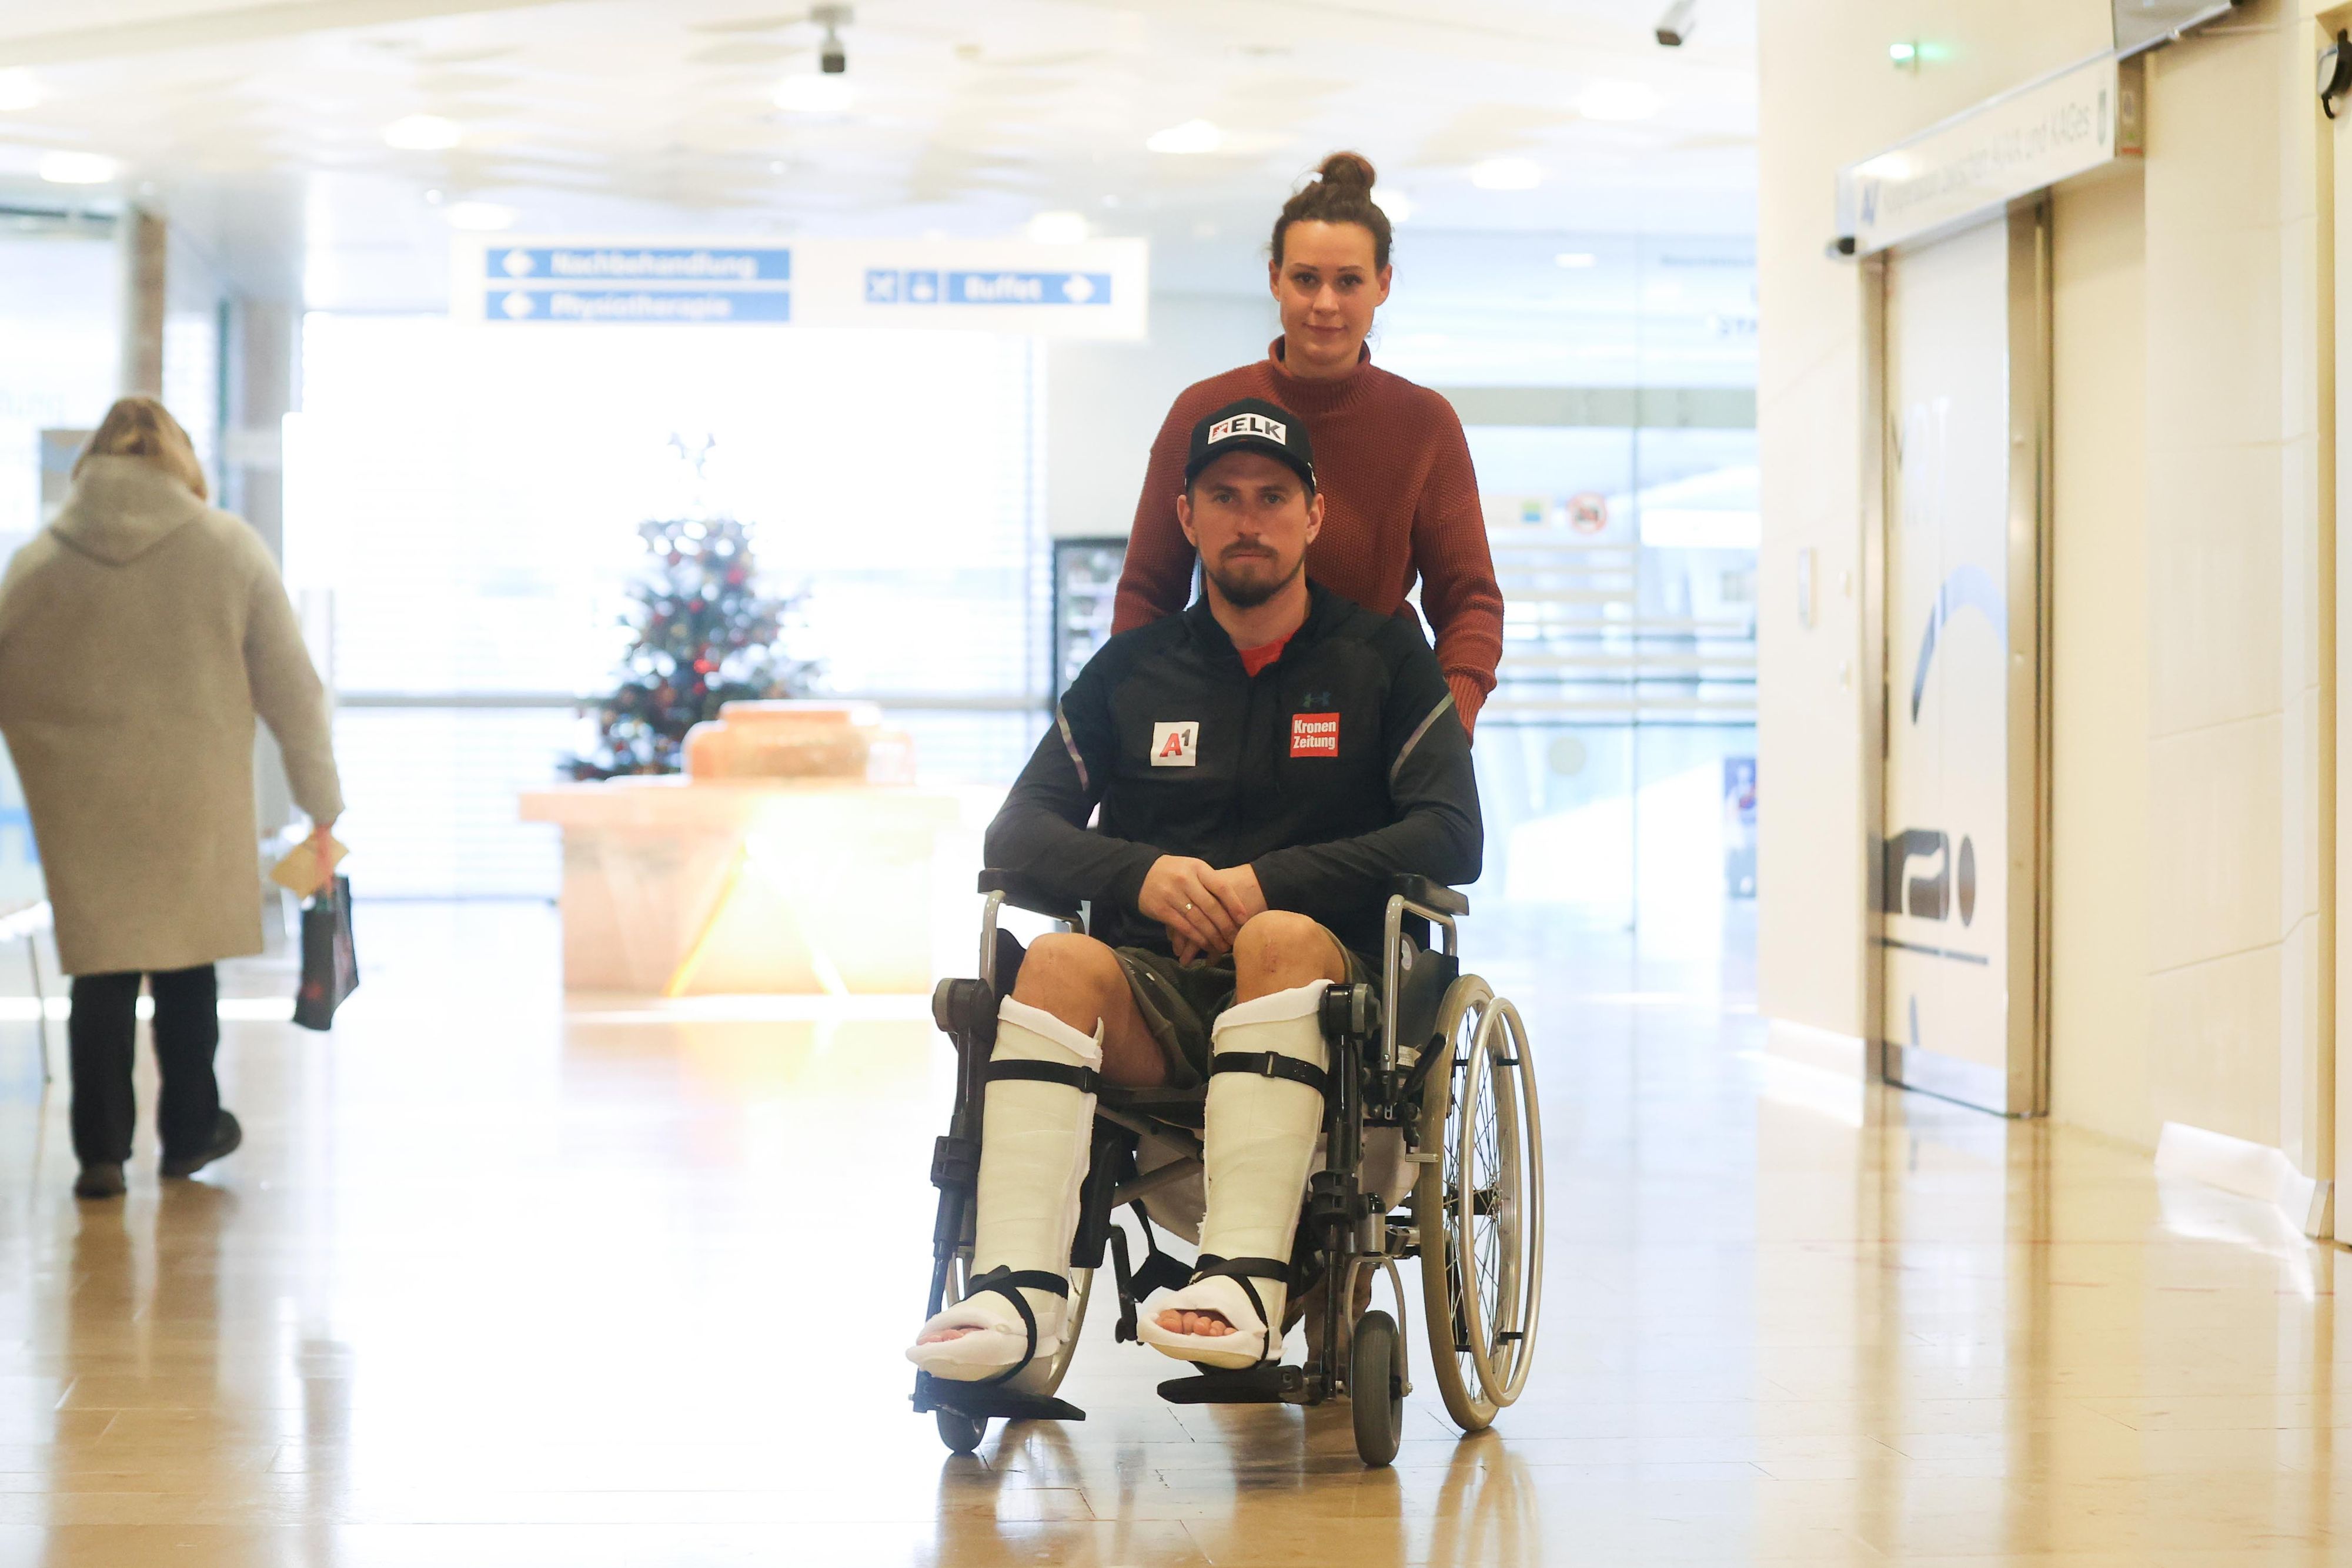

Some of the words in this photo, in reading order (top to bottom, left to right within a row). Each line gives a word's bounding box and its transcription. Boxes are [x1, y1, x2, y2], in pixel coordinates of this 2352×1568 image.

[551, 250, 757, 280] Nachbehandlung
[965, 274, 1043, 301] Buffet
[551, 293, 731, 321] Physiotherapie
[1231, 417, 1282, 440] ELK
[1294, 720, 1337, 734] Kronen
[1159, 729, 1191, 758] A1
[1294, 735, 1335, 750] Zeitung
